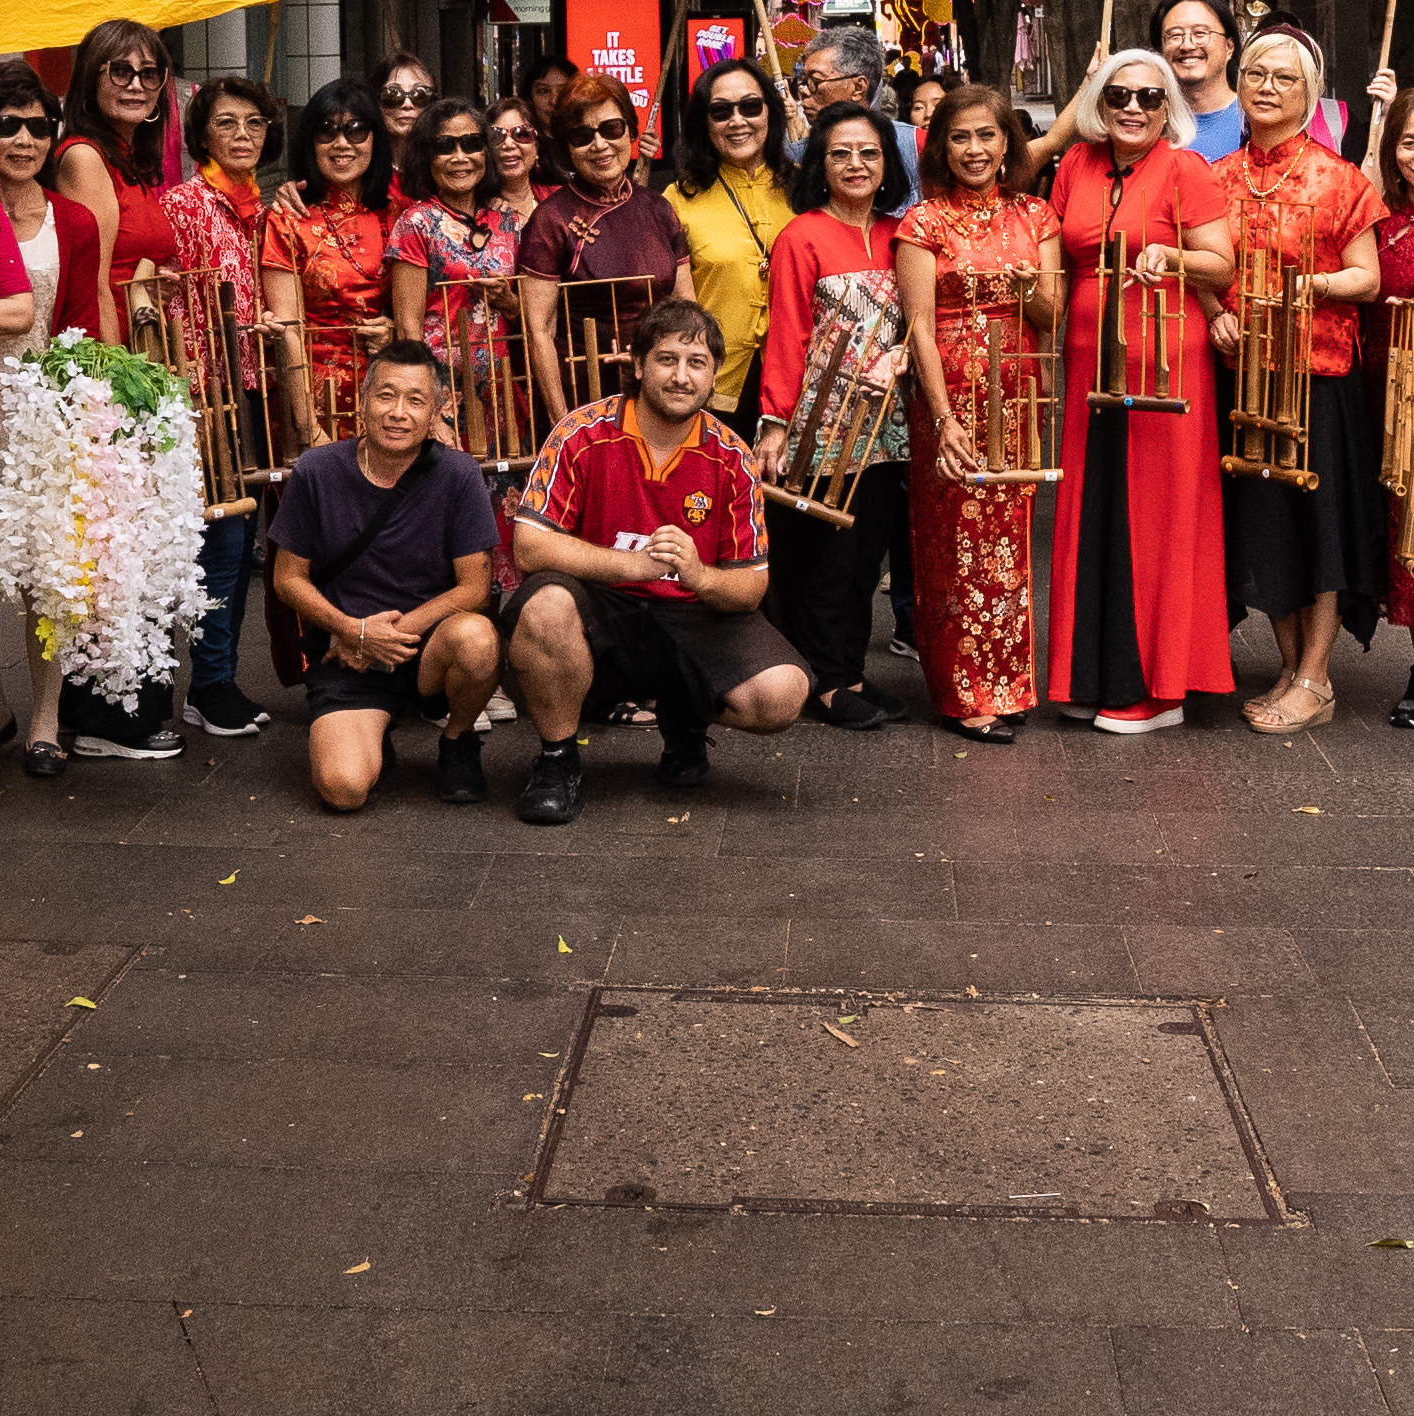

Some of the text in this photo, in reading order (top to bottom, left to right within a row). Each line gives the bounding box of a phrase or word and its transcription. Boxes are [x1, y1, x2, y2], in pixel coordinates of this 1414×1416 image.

[606, 31, 620, 48] IT
[696, 30, 735, 44] DOUBLE
[591, 48, 635, 66] TAKES
